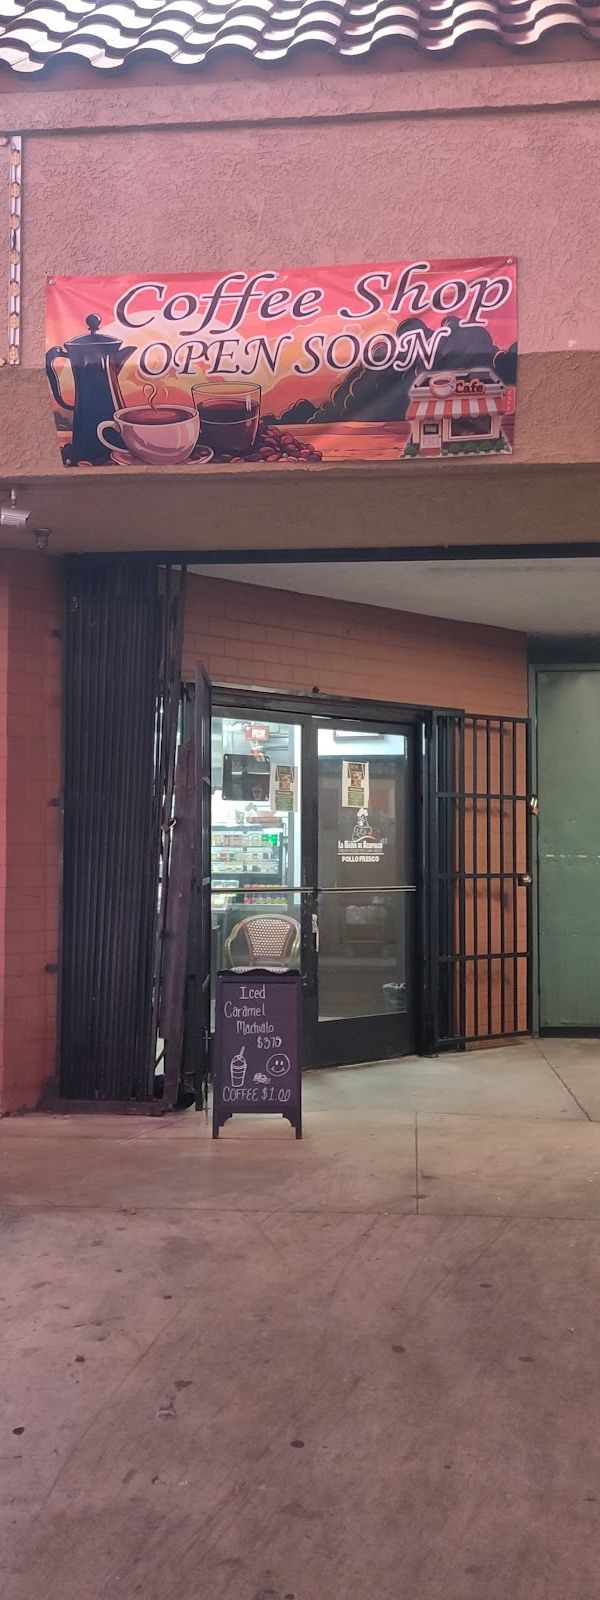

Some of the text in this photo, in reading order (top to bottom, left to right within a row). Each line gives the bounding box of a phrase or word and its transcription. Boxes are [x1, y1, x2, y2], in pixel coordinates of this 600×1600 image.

[116, 262, 511, 336] Coffee Shop
[138, 328, 449, 376] OPEN SOON
[455, 380, 484, 394] Cafe
[240, 984, 266, 1000] Iced
[224, 1001, 266, 1018] Caramel
[222, 1086, 259, 1101] COFFEE
